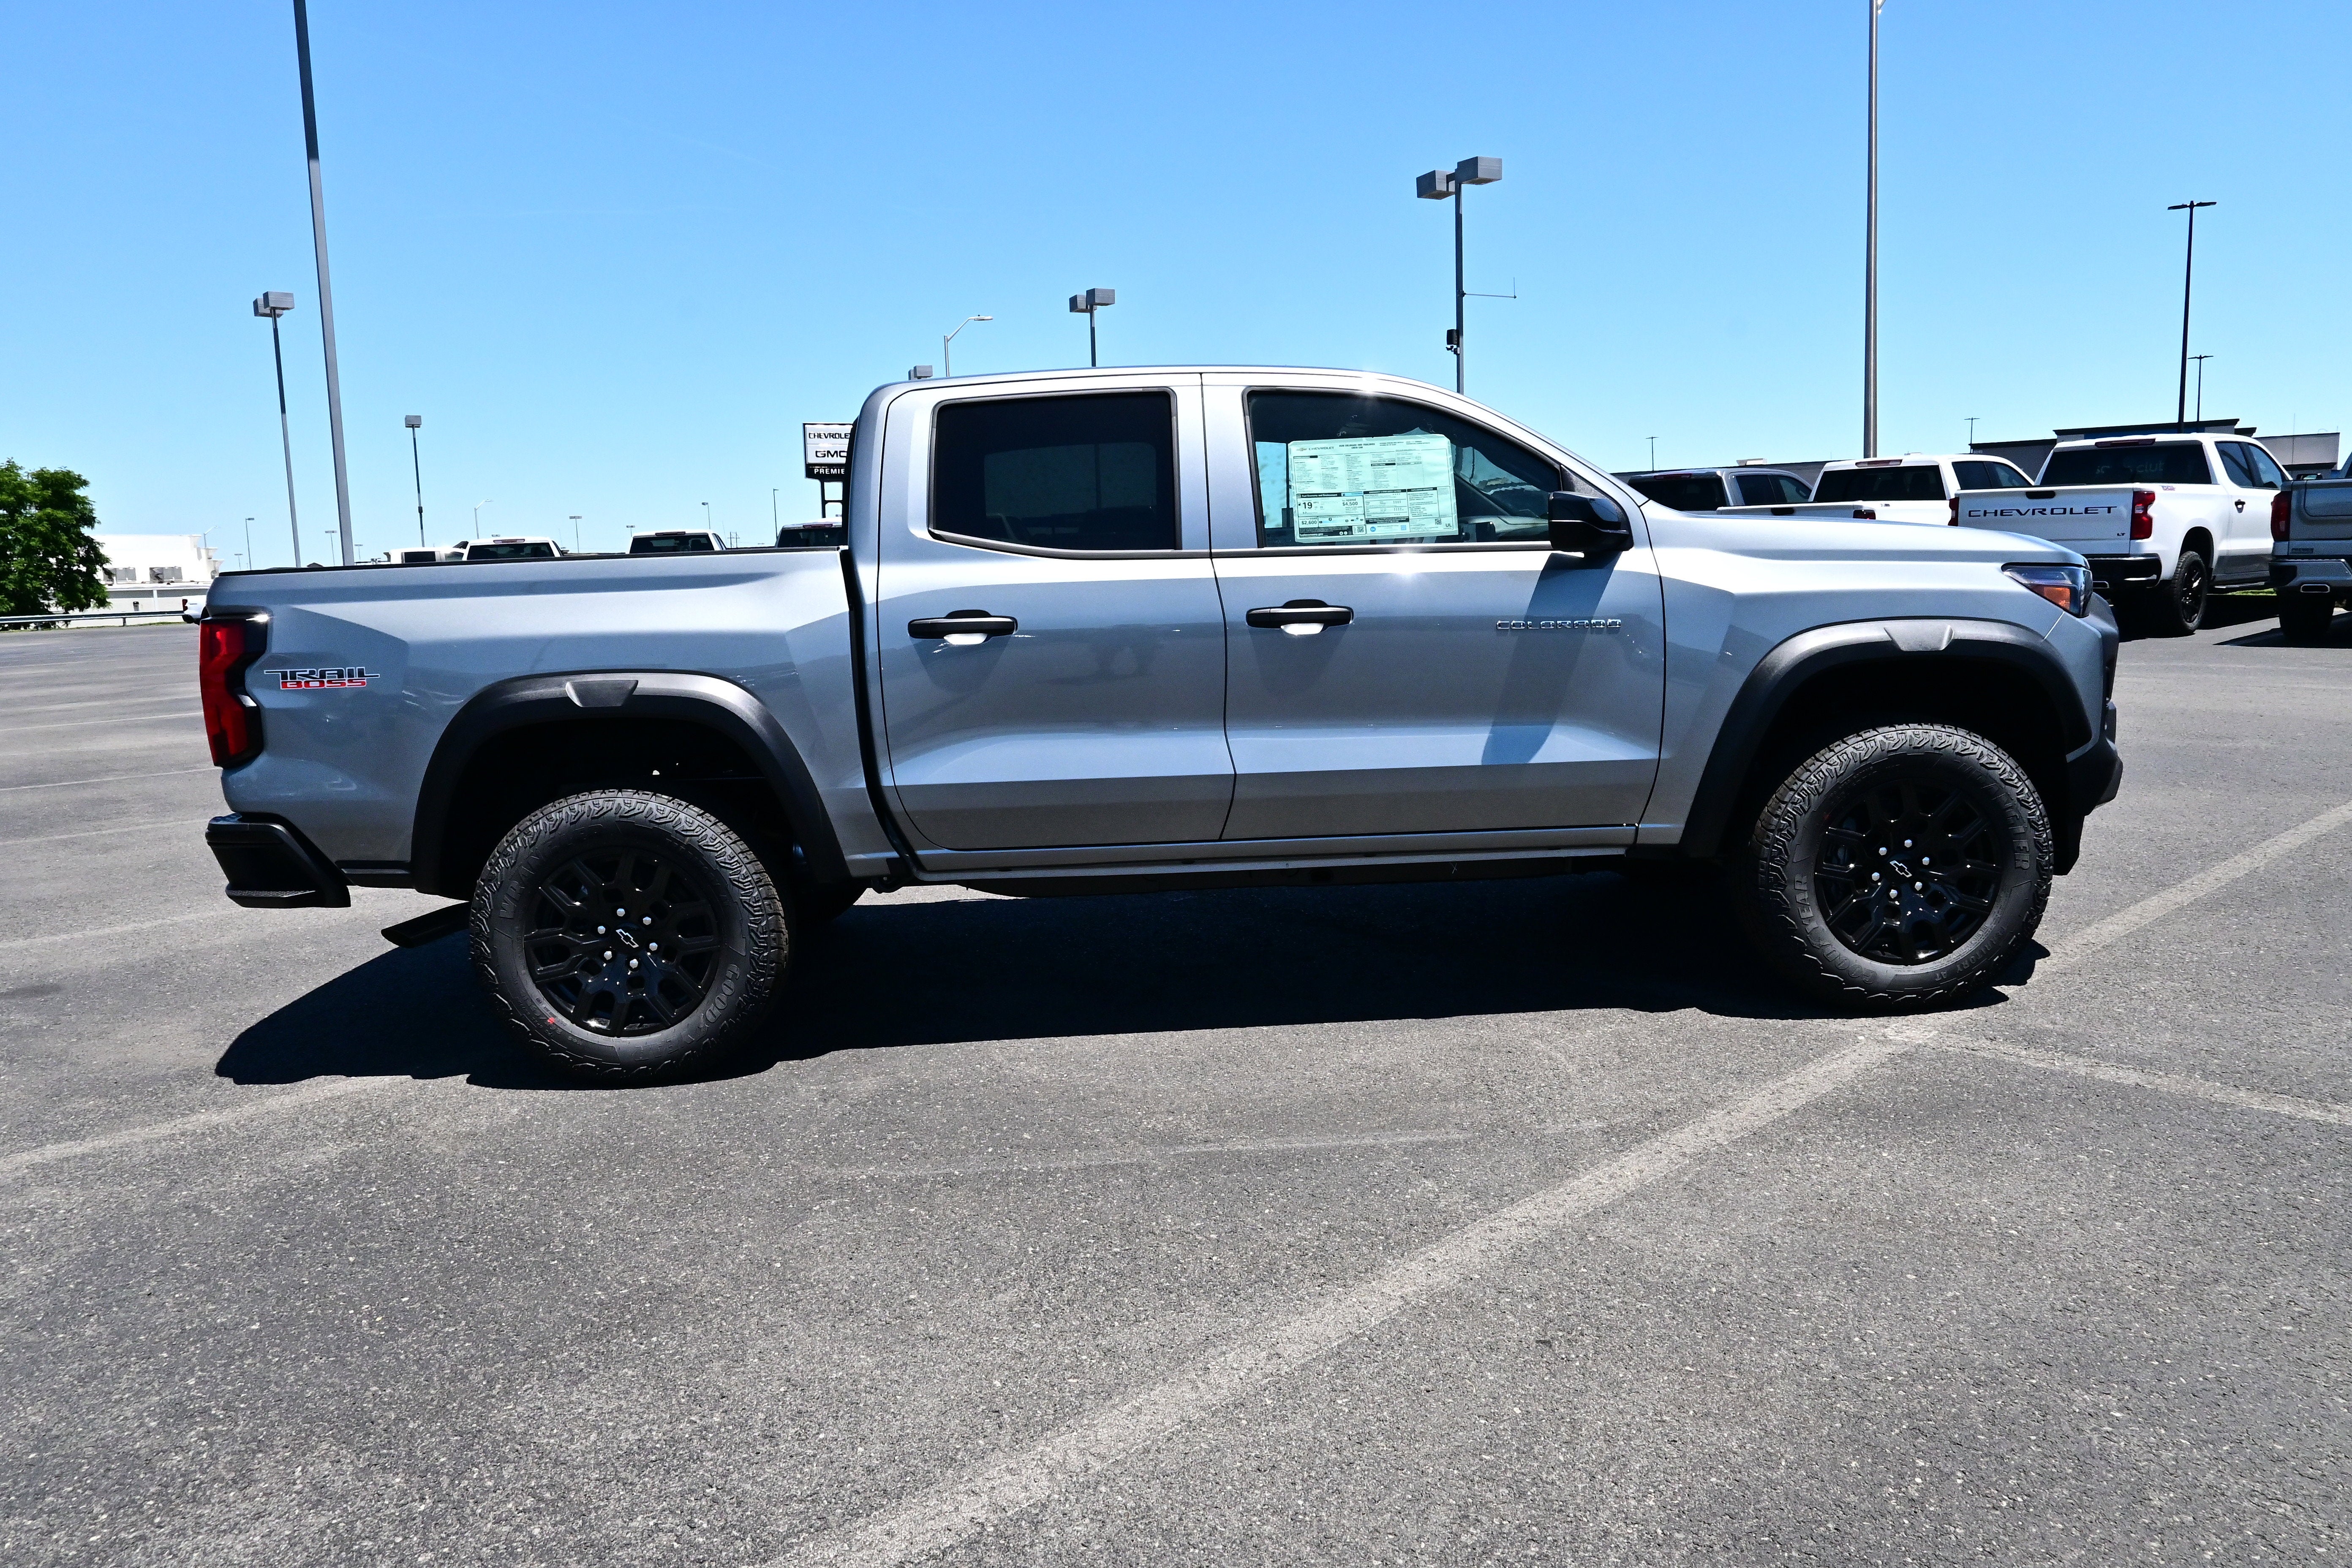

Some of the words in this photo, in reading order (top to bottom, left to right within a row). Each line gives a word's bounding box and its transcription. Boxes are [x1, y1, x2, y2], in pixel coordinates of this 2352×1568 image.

[1968, 506, 2117, 517] CHEVROLET
[1496, 619, 1622, 630] COLORADO
[264, 667, 380, 681] TRAIL
[280, 678, 367, 689] BOSS
